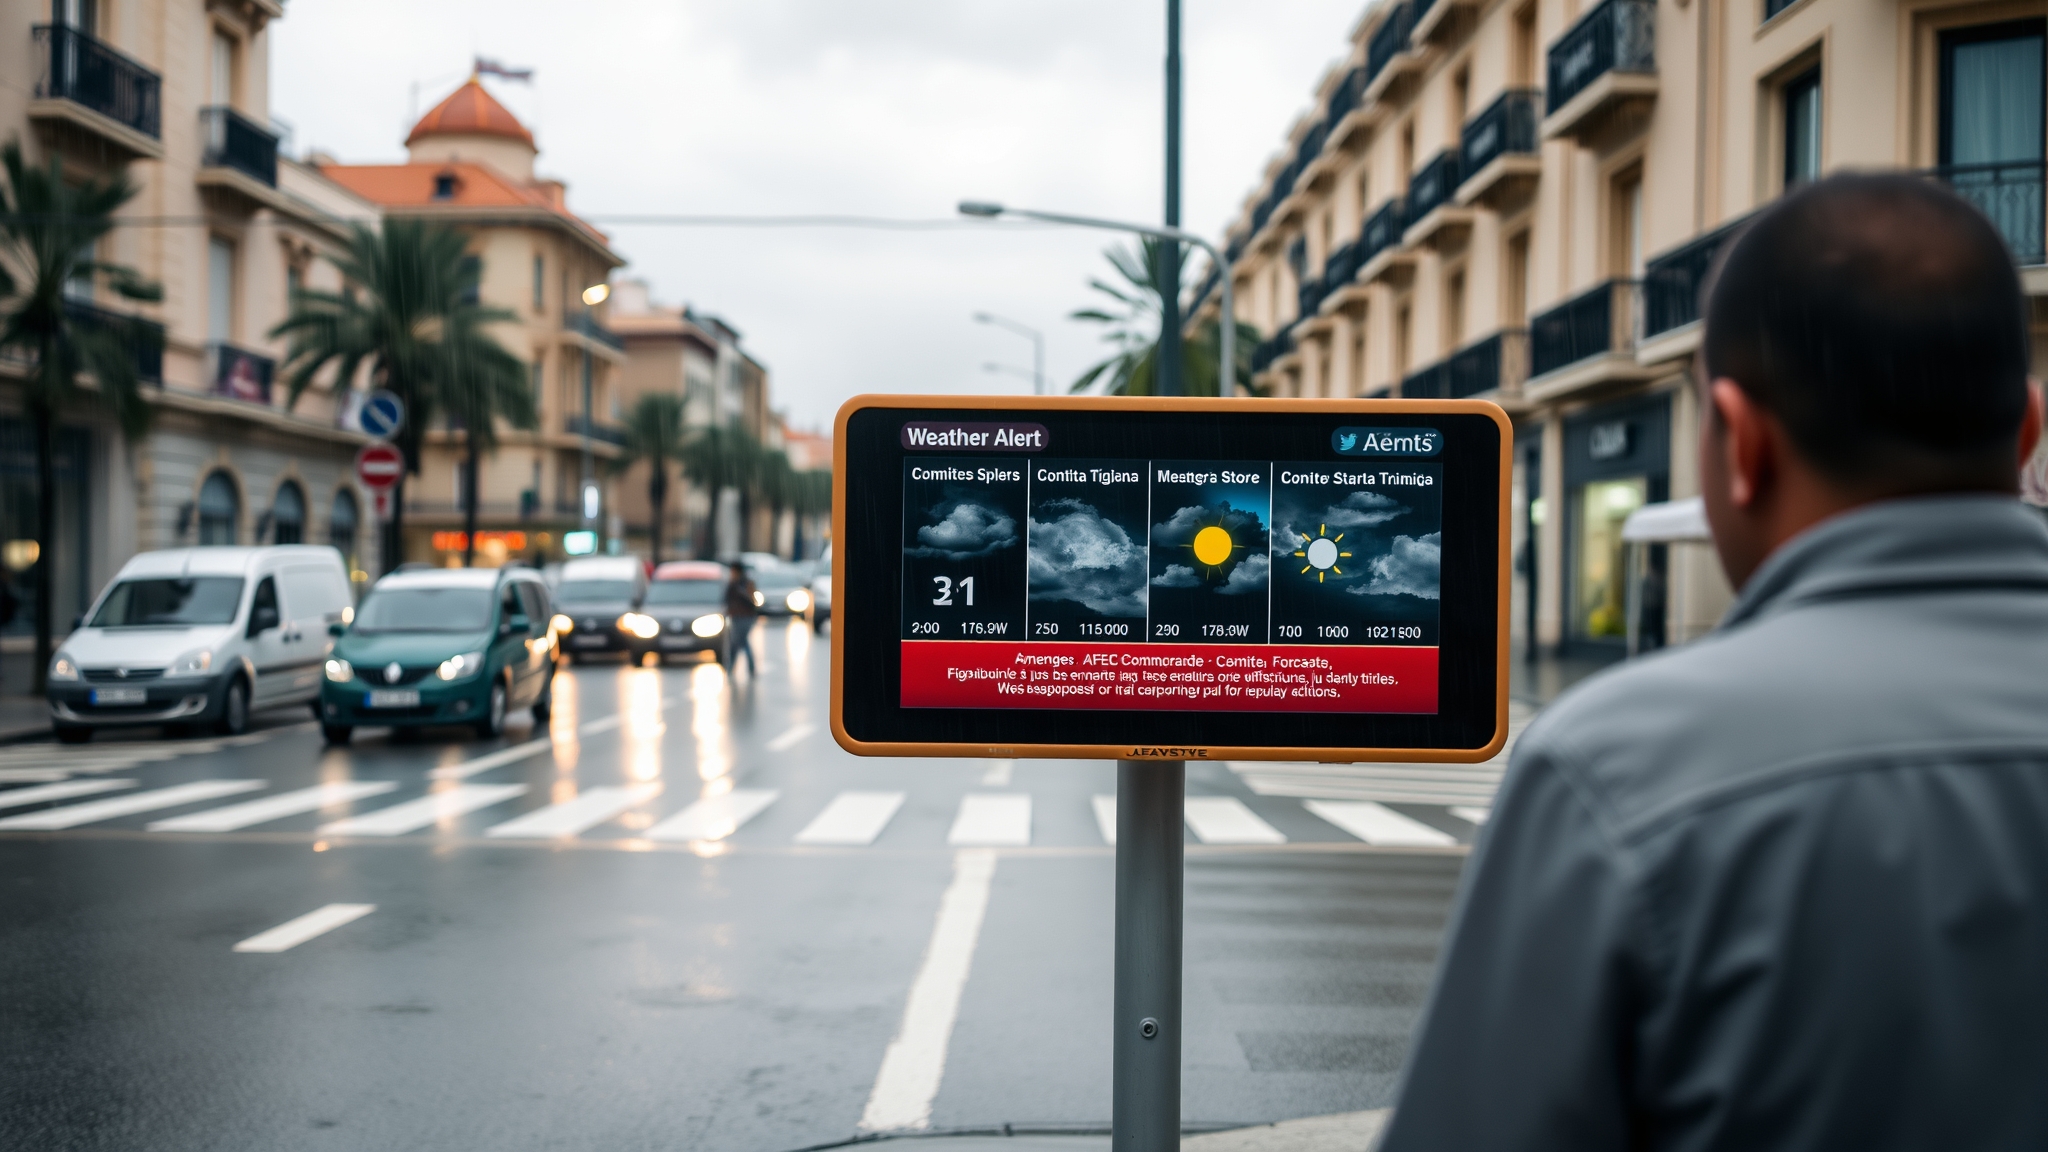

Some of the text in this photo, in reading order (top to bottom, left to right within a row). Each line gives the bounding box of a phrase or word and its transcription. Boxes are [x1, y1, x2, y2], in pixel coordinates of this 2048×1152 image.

[907, 428, 1042, 447] Weather Alert
[1221, 470, 1260, 484] Store
[1035, 623, 1059, 635] 250
[1224, 684, 1242, 696] for
